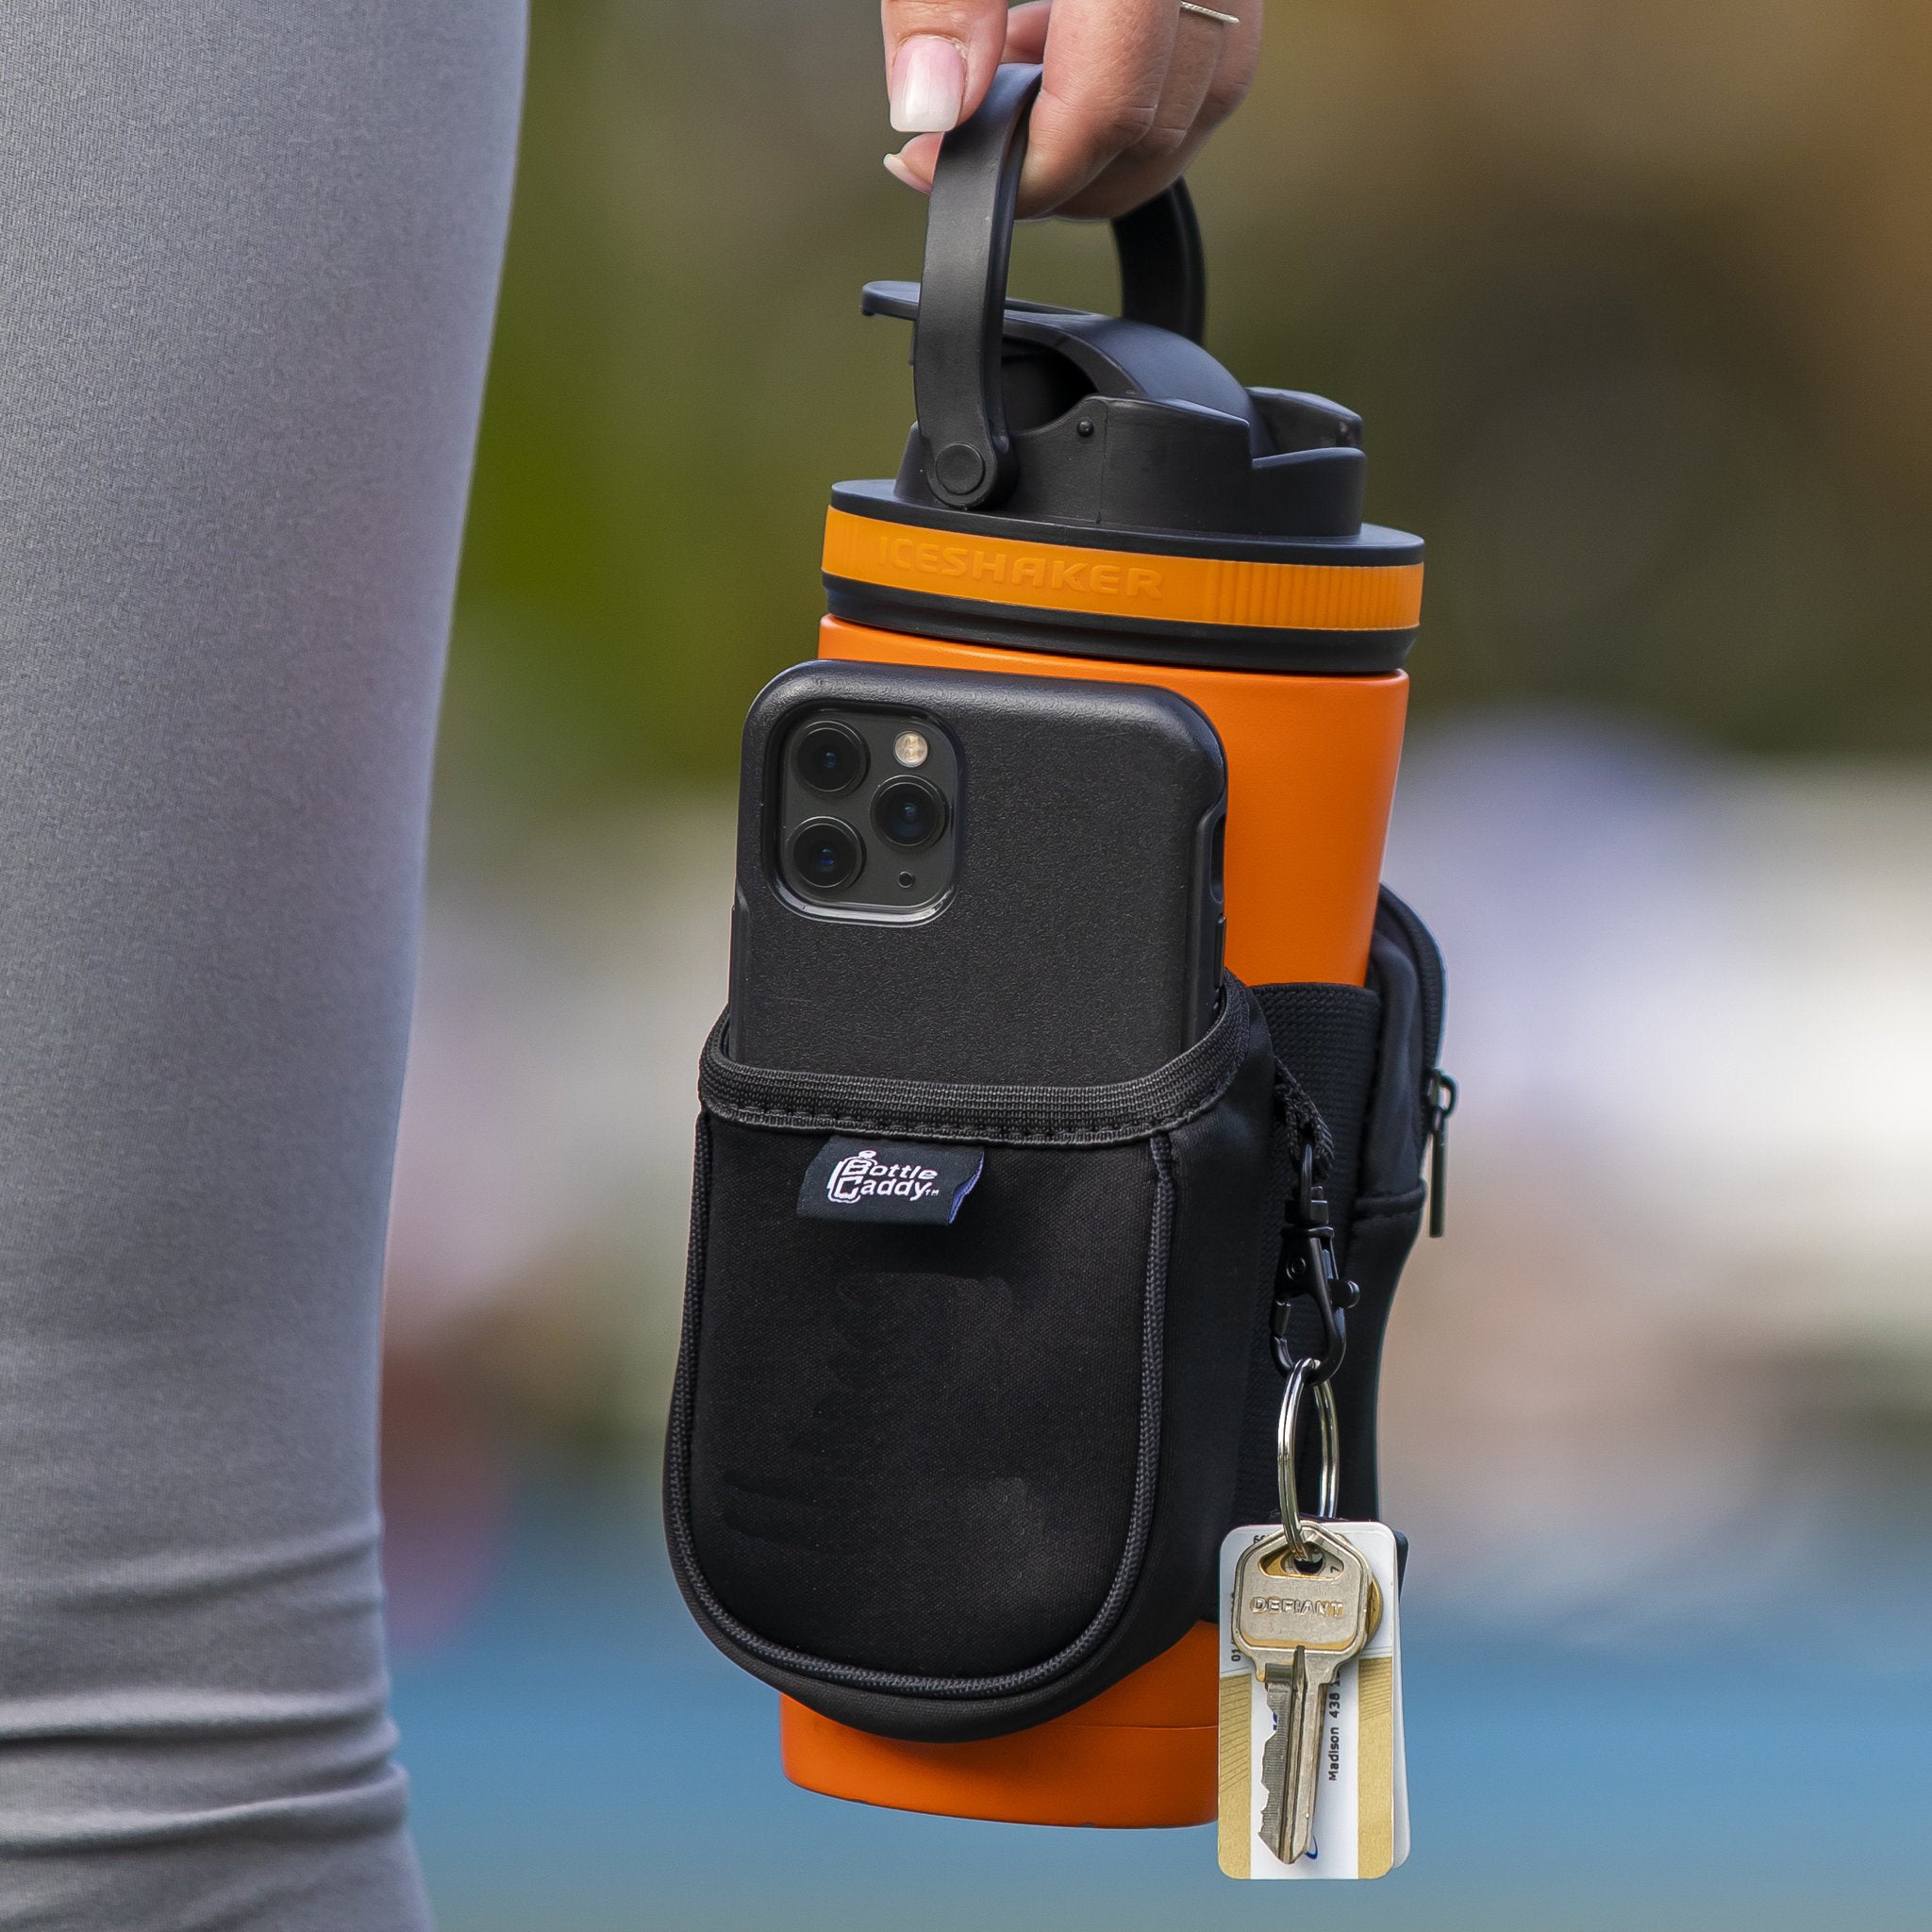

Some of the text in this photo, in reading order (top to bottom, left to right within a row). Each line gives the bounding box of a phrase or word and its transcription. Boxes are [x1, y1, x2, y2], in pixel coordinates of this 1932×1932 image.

[880, 535, 1162, 599] ICESHAKER
[841, 1157, 939, 1180] Bottle
[1251, 1595, 1343, 1618] DEFIANT
[1328, 1692, 1340, 1719] 438
[1328, 1726, 1340, 1781] Madison
